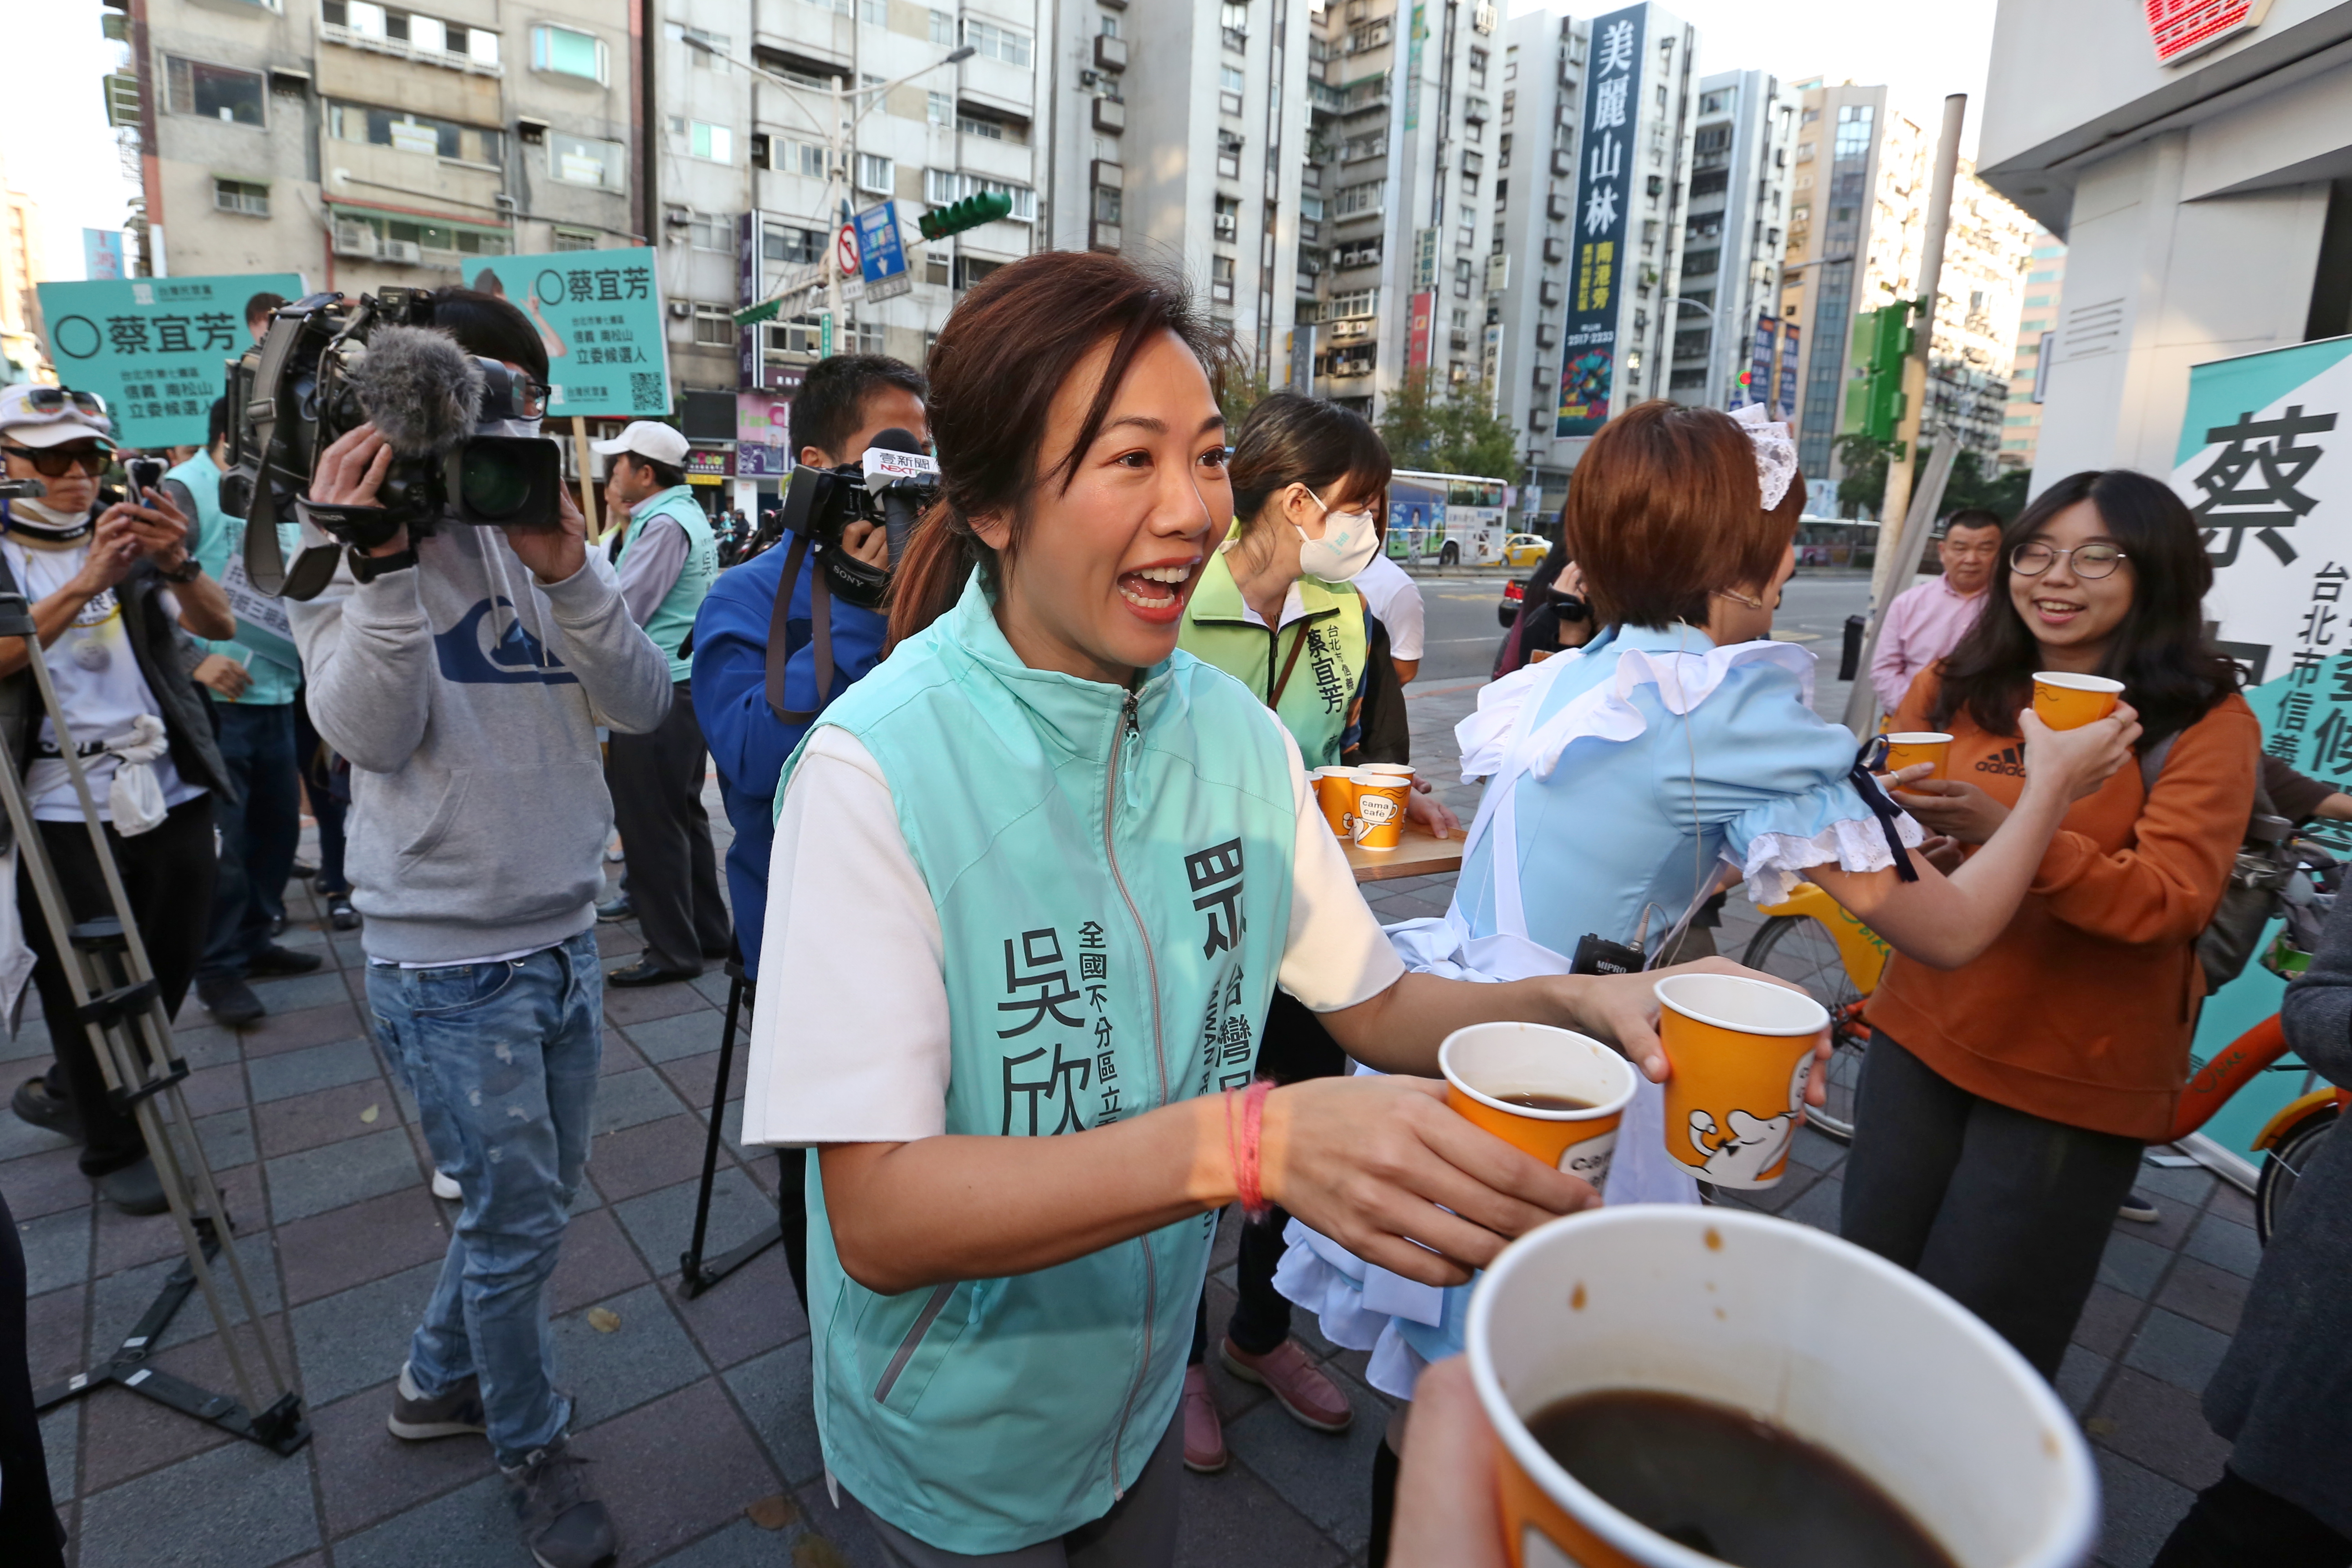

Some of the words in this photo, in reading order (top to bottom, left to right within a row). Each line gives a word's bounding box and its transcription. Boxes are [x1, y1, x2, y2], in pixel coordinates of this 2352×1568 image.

[1583, 20, 1635, 236] 美麗山林
[567, 266, 649, 302] 蔡宜芳
[107, 313, 237, 355] 蔡宜芳
[576, 346, 647, 364] 立委候選人
[880, 452, 930, 470] 壹新聞
[833, 565, 864, 587] SONY
[1307, 629, 1345, 715] 蔡宜芳
[1362, 800, 1389, 810] cama
[1364, 809, 1385, 817] café
[1596, 960, 1627, 974] MIPRO
[1078, 921, 1122, 1128] 全國不分區立
